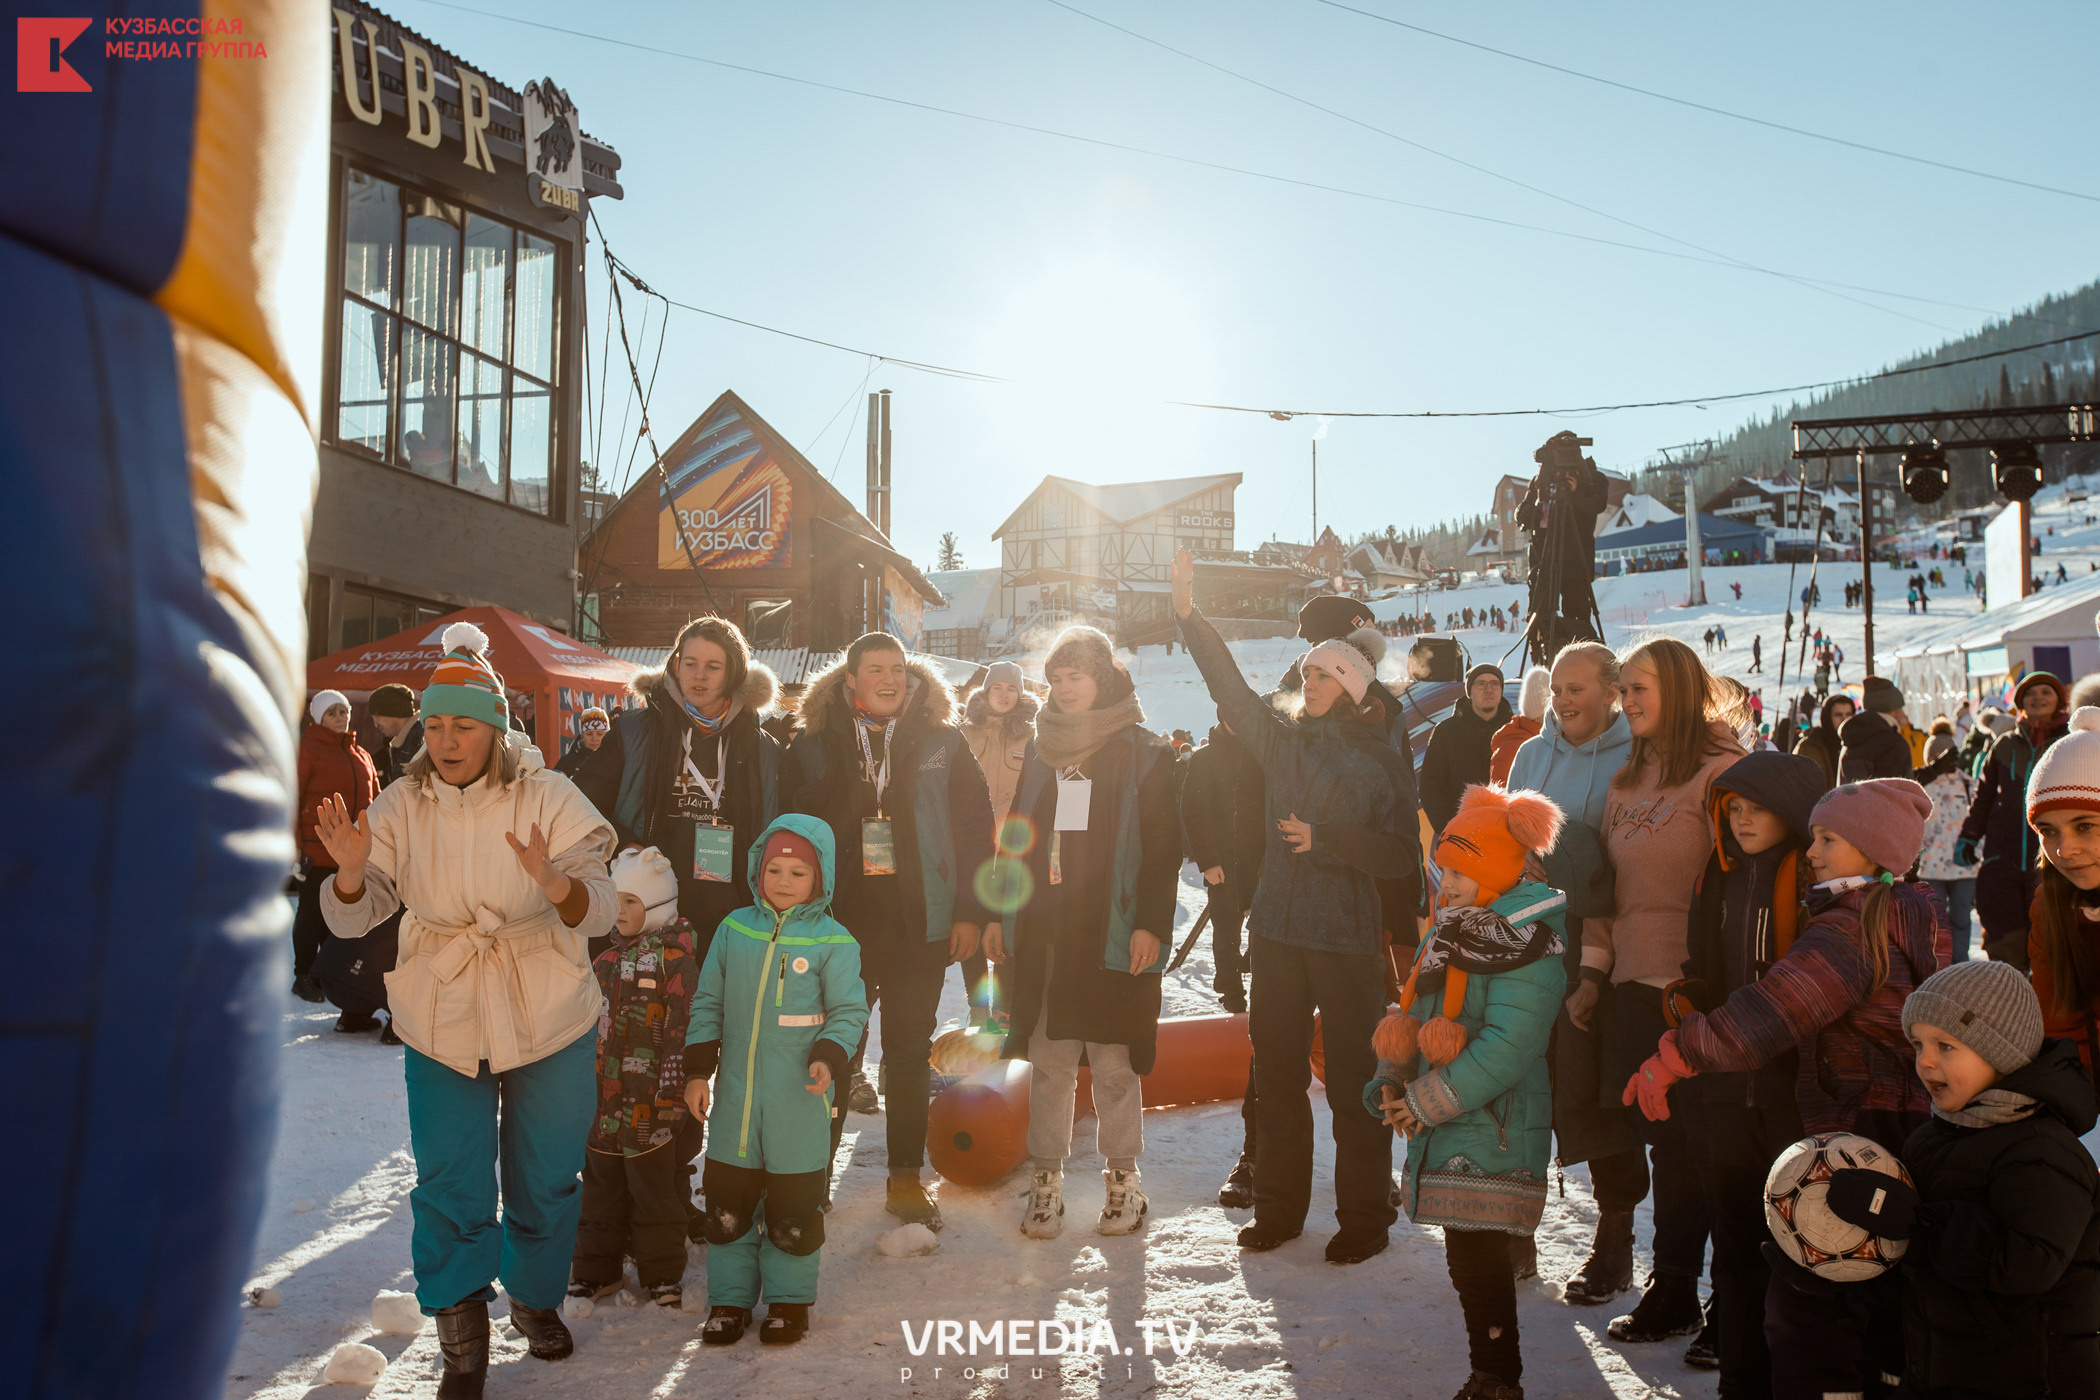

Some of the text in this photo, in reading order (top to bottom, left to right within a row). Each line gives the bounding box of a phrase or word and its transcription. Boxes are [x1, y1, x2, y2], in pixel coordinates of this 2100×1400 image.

[332, 7, 497, 174] UBR
[539, 181, 580, 212] ZUBR
[677, 509, 719, 529] 300
[1181, 515, 1233, 528] ROOKS
[334, 661, 409, 674] МЕДИА
